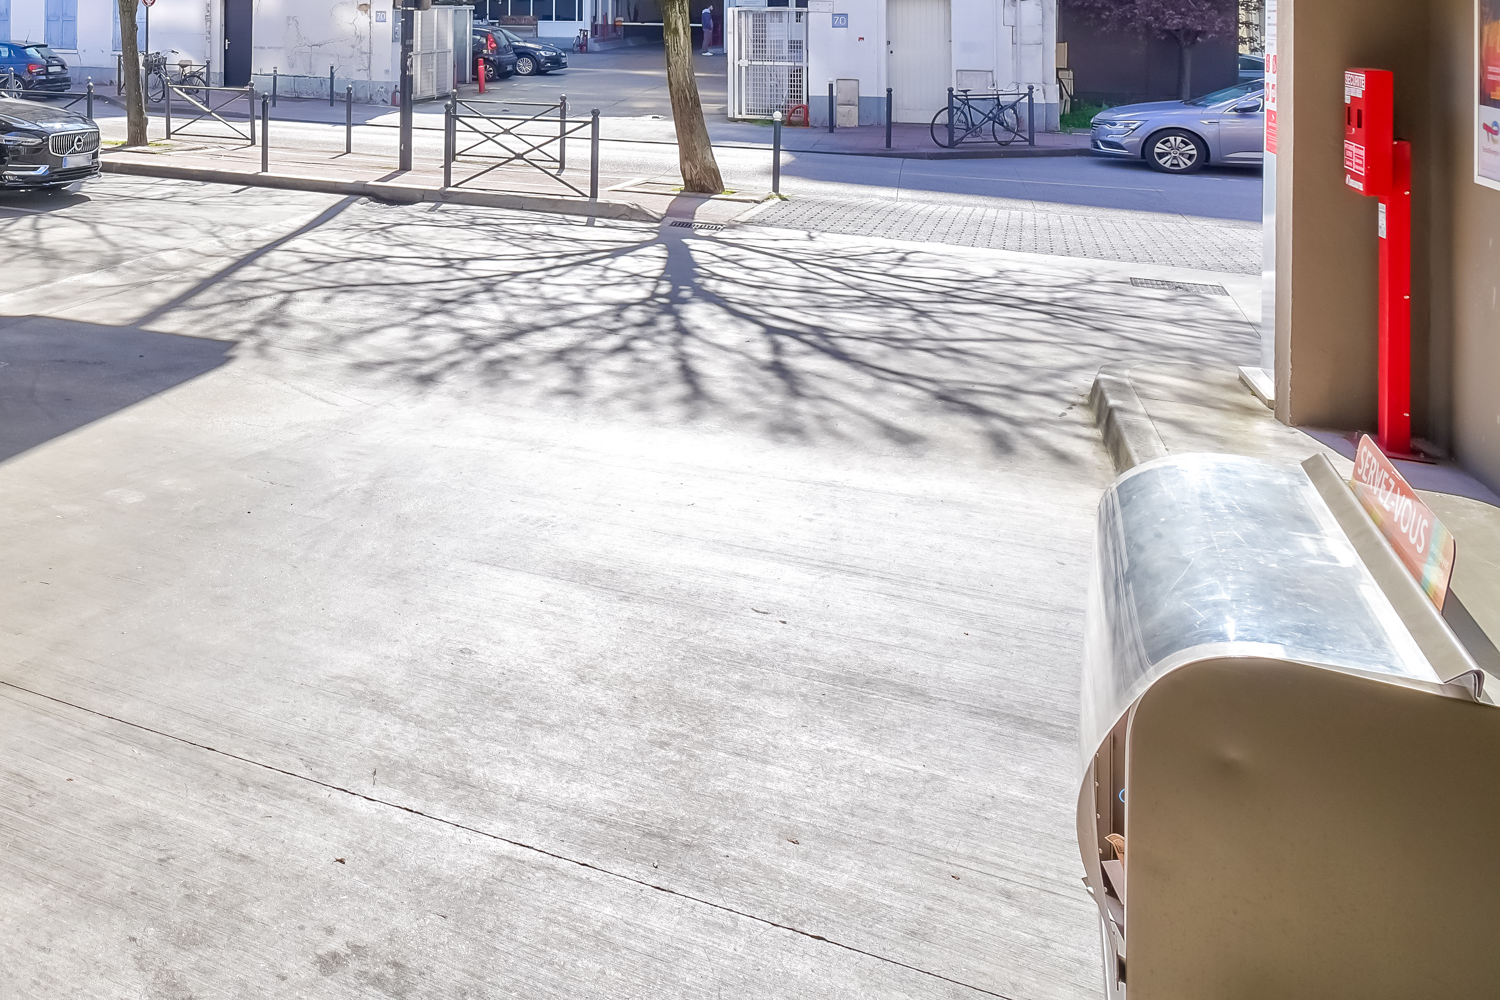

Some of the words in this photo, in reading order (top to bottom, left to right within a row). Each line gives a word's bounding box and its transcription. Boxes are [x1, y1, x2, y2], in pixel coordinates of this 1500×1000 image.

[376, 12, 386, 21] 70
[833, 16, 846, 26] 70
[1357, 446, 1429, 554] SERVEZ-VOUS
